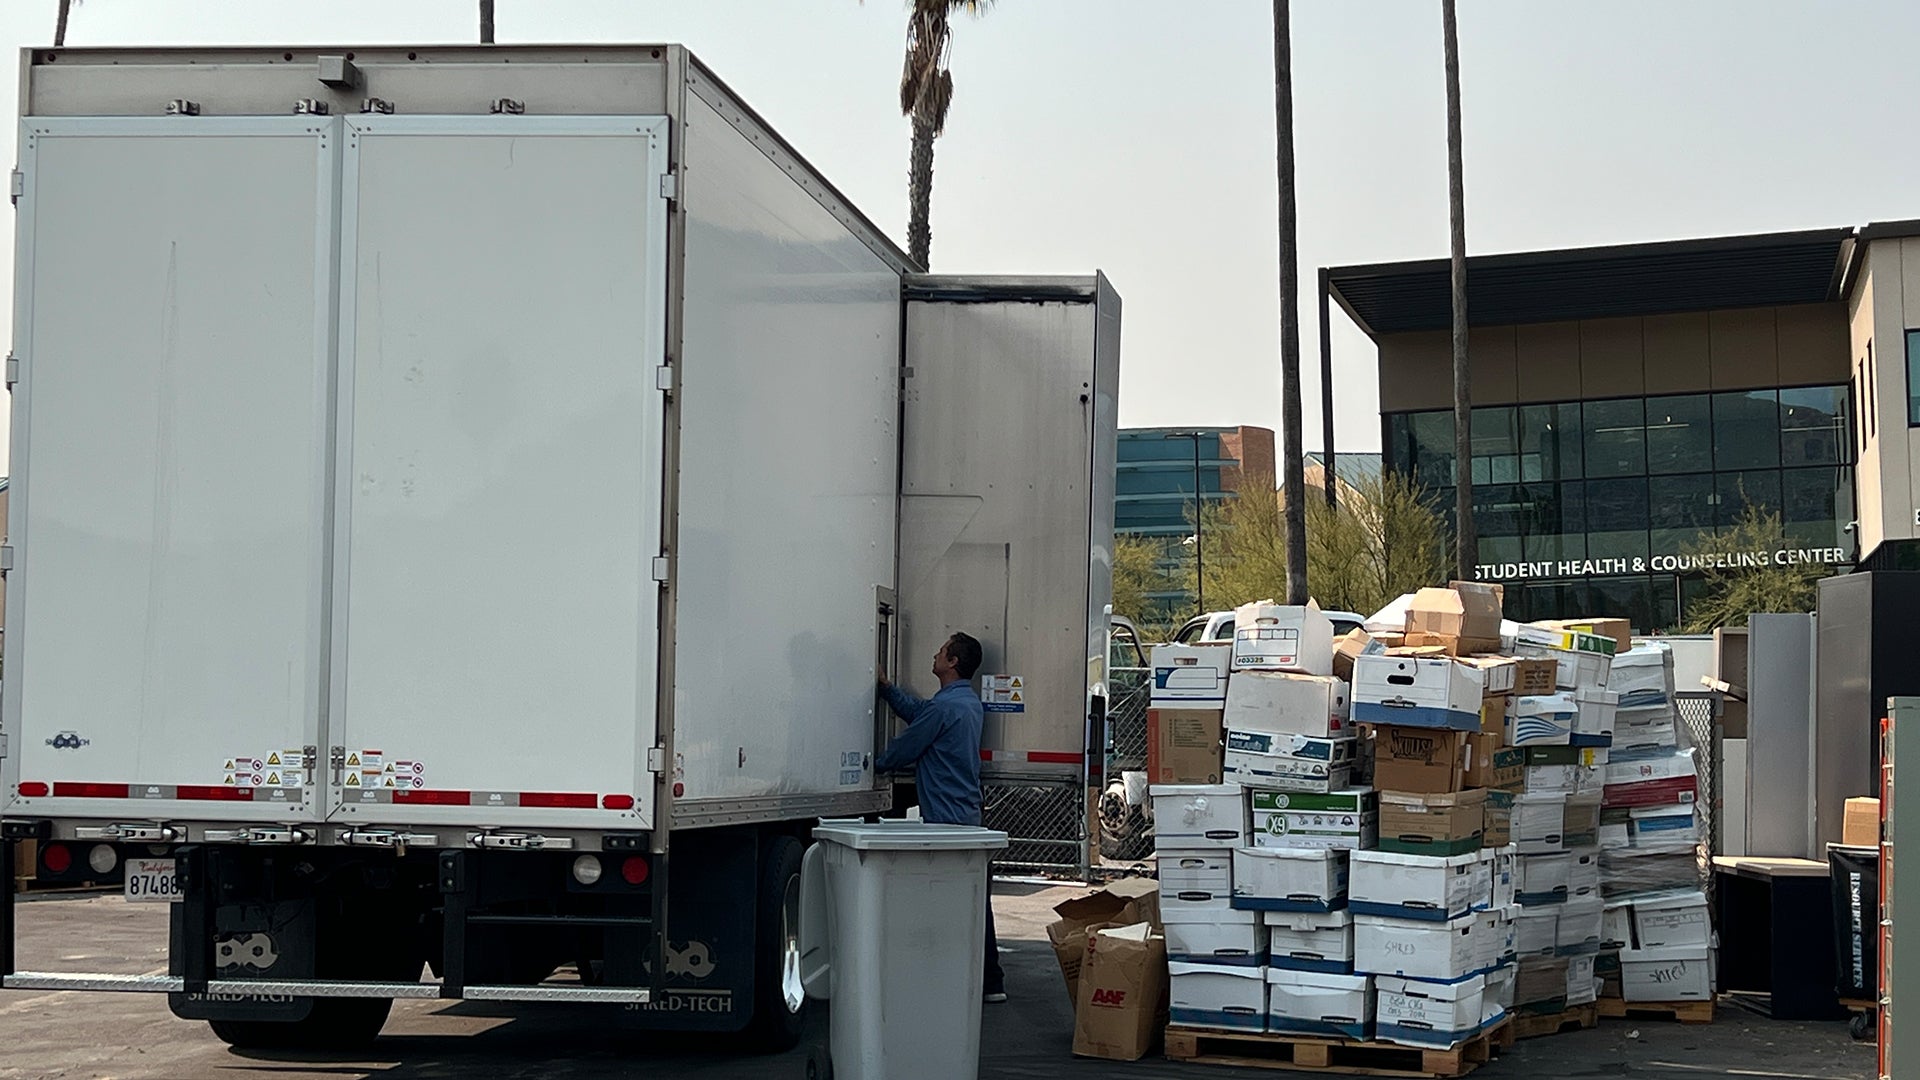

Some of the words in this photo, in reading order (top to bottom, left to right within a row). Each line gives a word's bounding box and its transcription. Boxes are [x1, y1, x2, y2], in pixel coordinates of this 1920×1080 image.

[1558, 558, 1626, 576] HEALTH
[1632, 557, 1646, 572] &
[1651, 551, 1769, 571] COUNSELING
[1775, 548, 1845, 565] CENTER
[1270, 816, 1286, 833] X9
[130, 875, 183, 895] 87488
[1850, 872, 1862, 932] RESOURCE
[1091, 988, 1126, 1005] AAF
